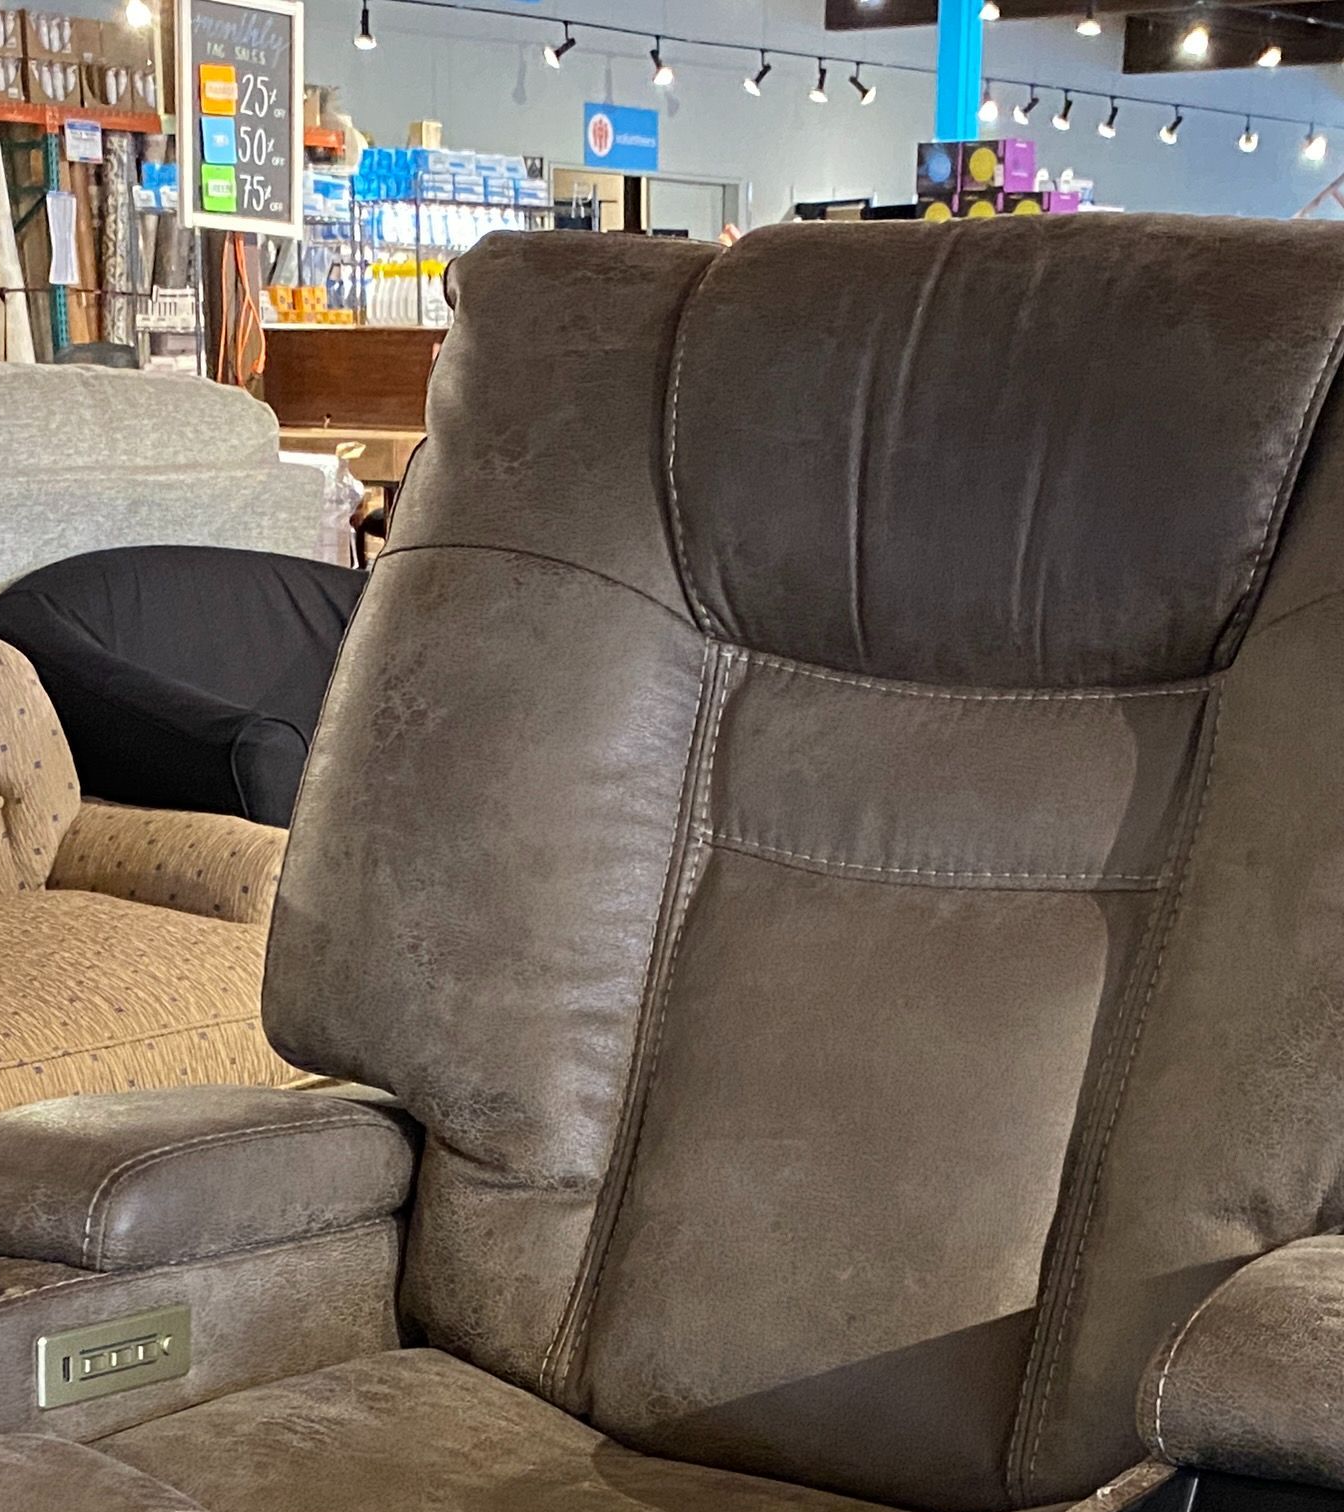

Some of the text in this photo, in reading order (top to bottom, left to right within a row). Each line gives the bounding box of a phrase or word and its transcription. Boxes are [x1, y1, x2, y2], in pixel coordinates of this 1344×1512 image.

[207, 42, 266, 65] TAG SALES
[238, 126, 274, 165] 50%
[239, 174, 272, 212] 75%
